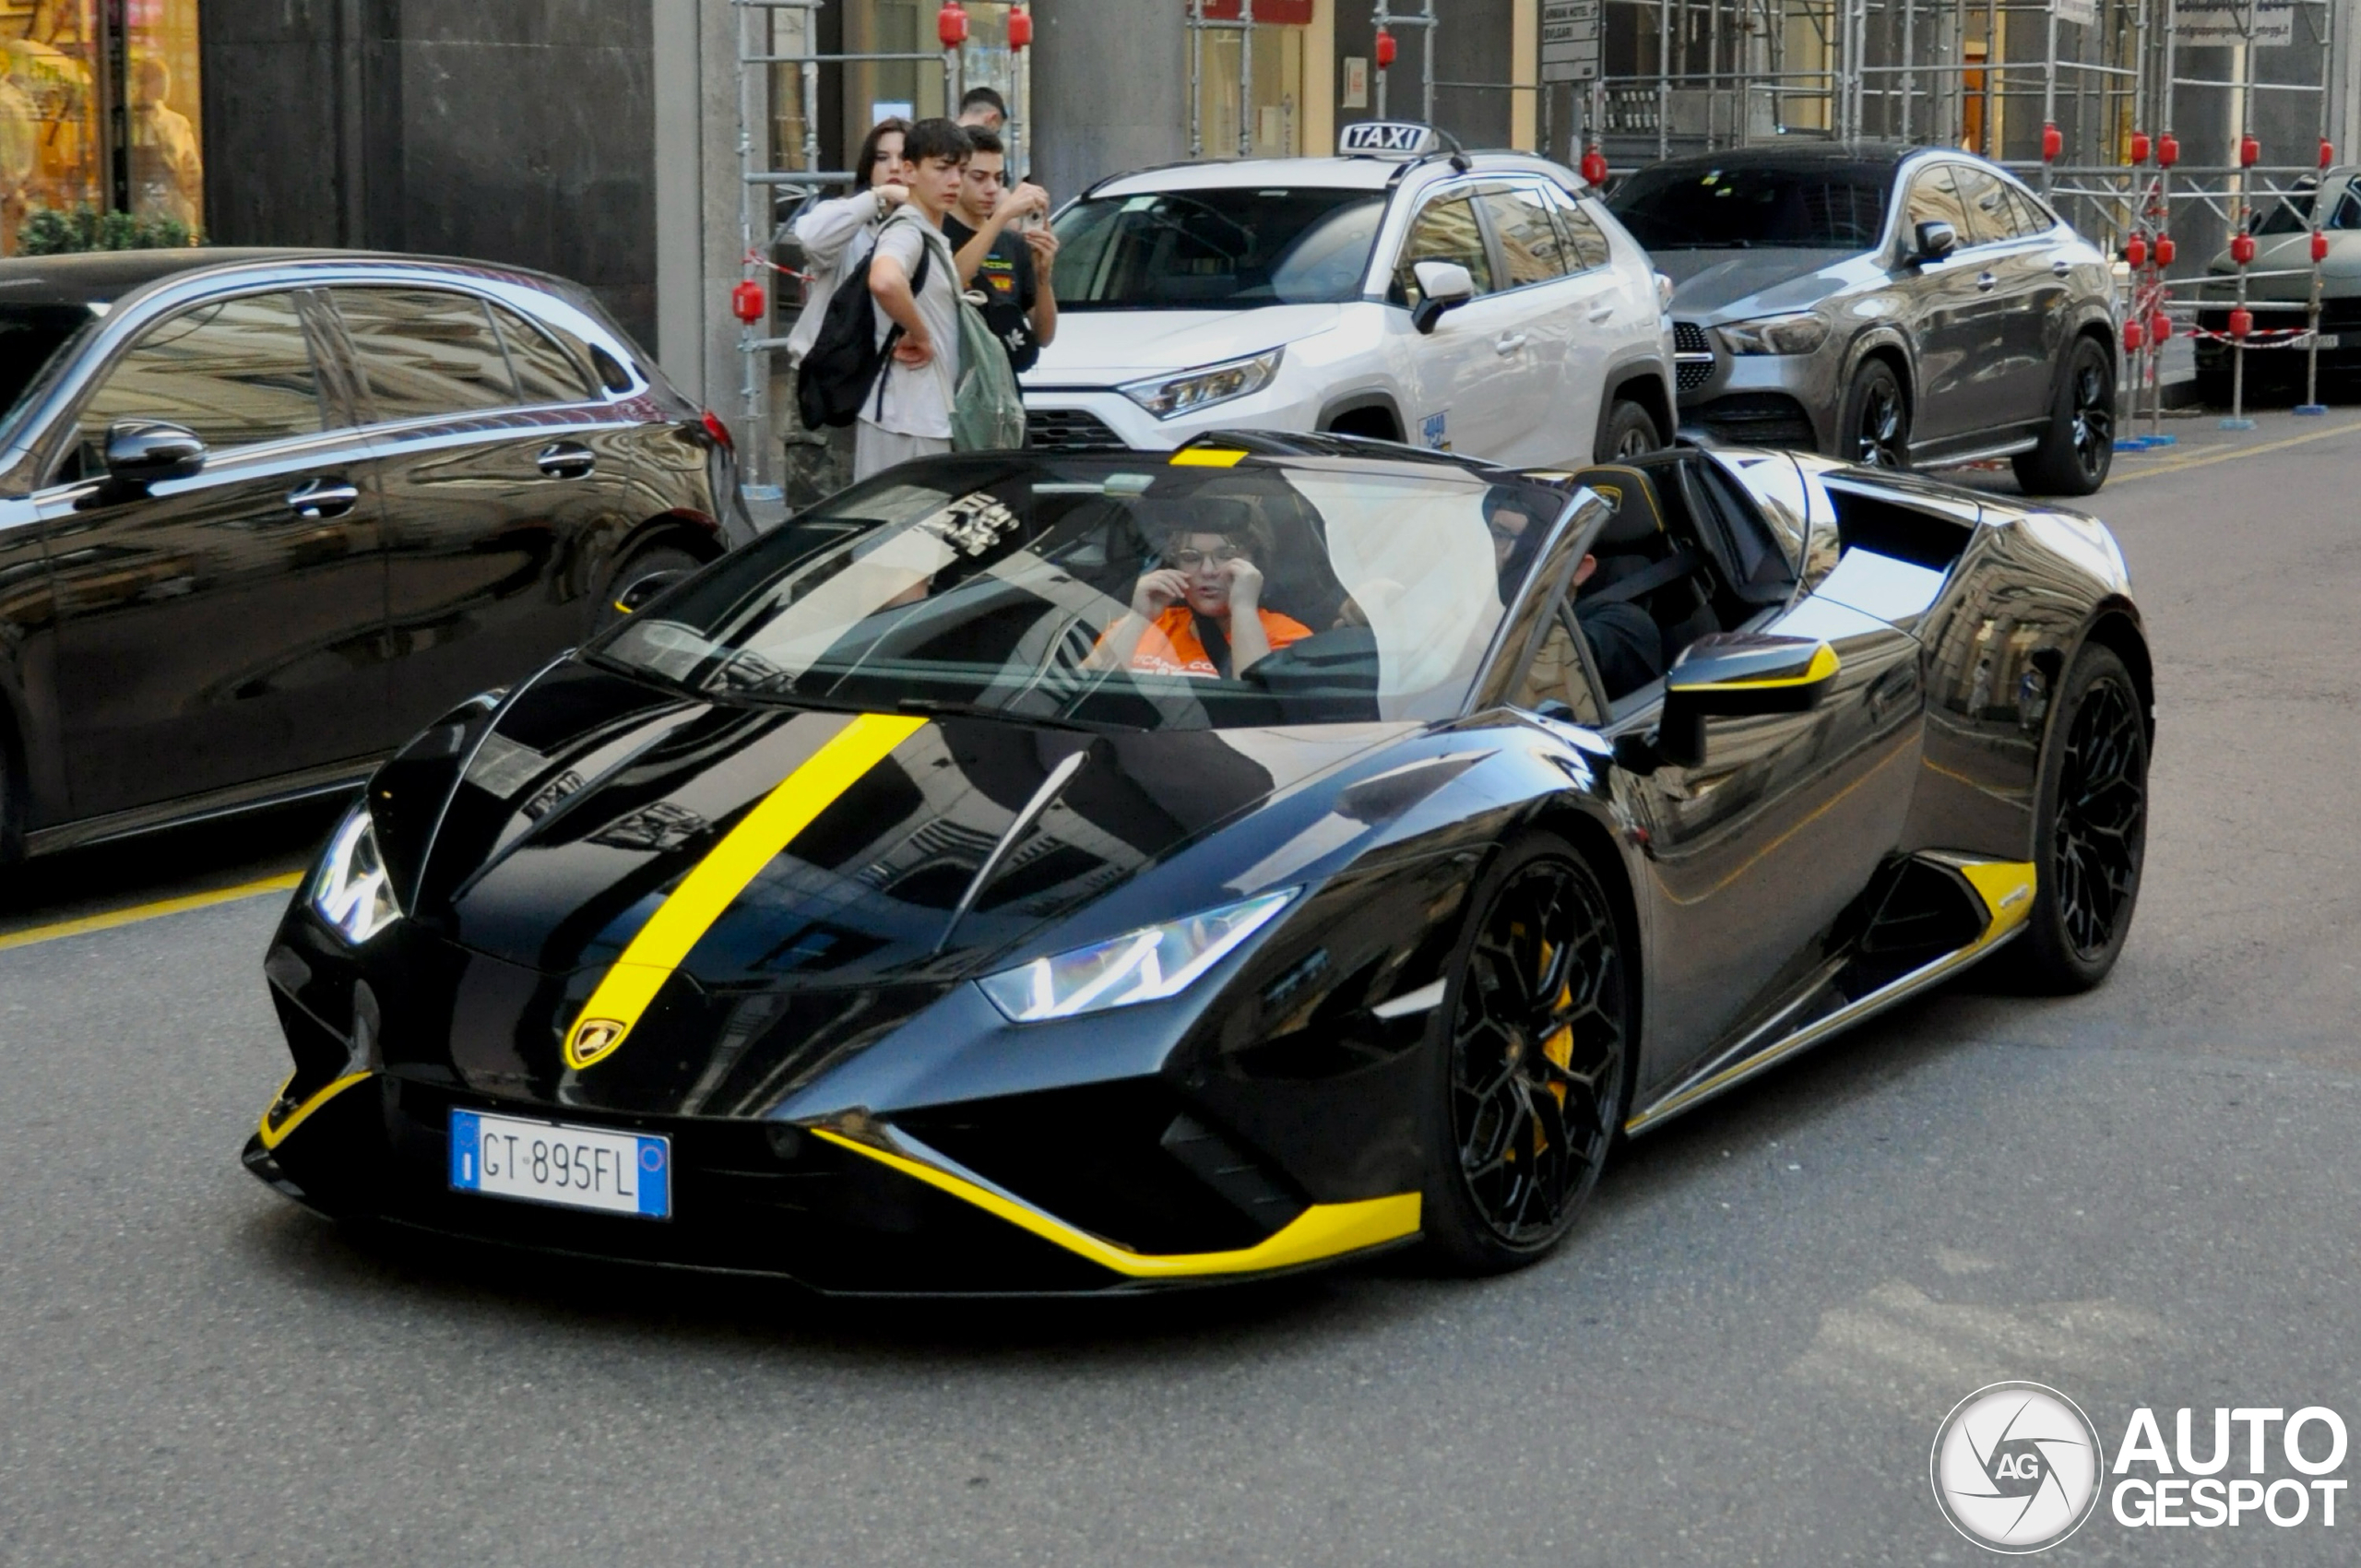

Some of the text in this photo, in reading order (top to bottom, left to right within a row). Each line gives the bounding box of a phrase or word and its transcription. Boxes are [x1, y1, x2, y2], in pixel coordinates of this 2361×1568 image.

[1353, 126, 1418, 149] TAXI
[483, 1133, 635, 1197] GT 895FL
